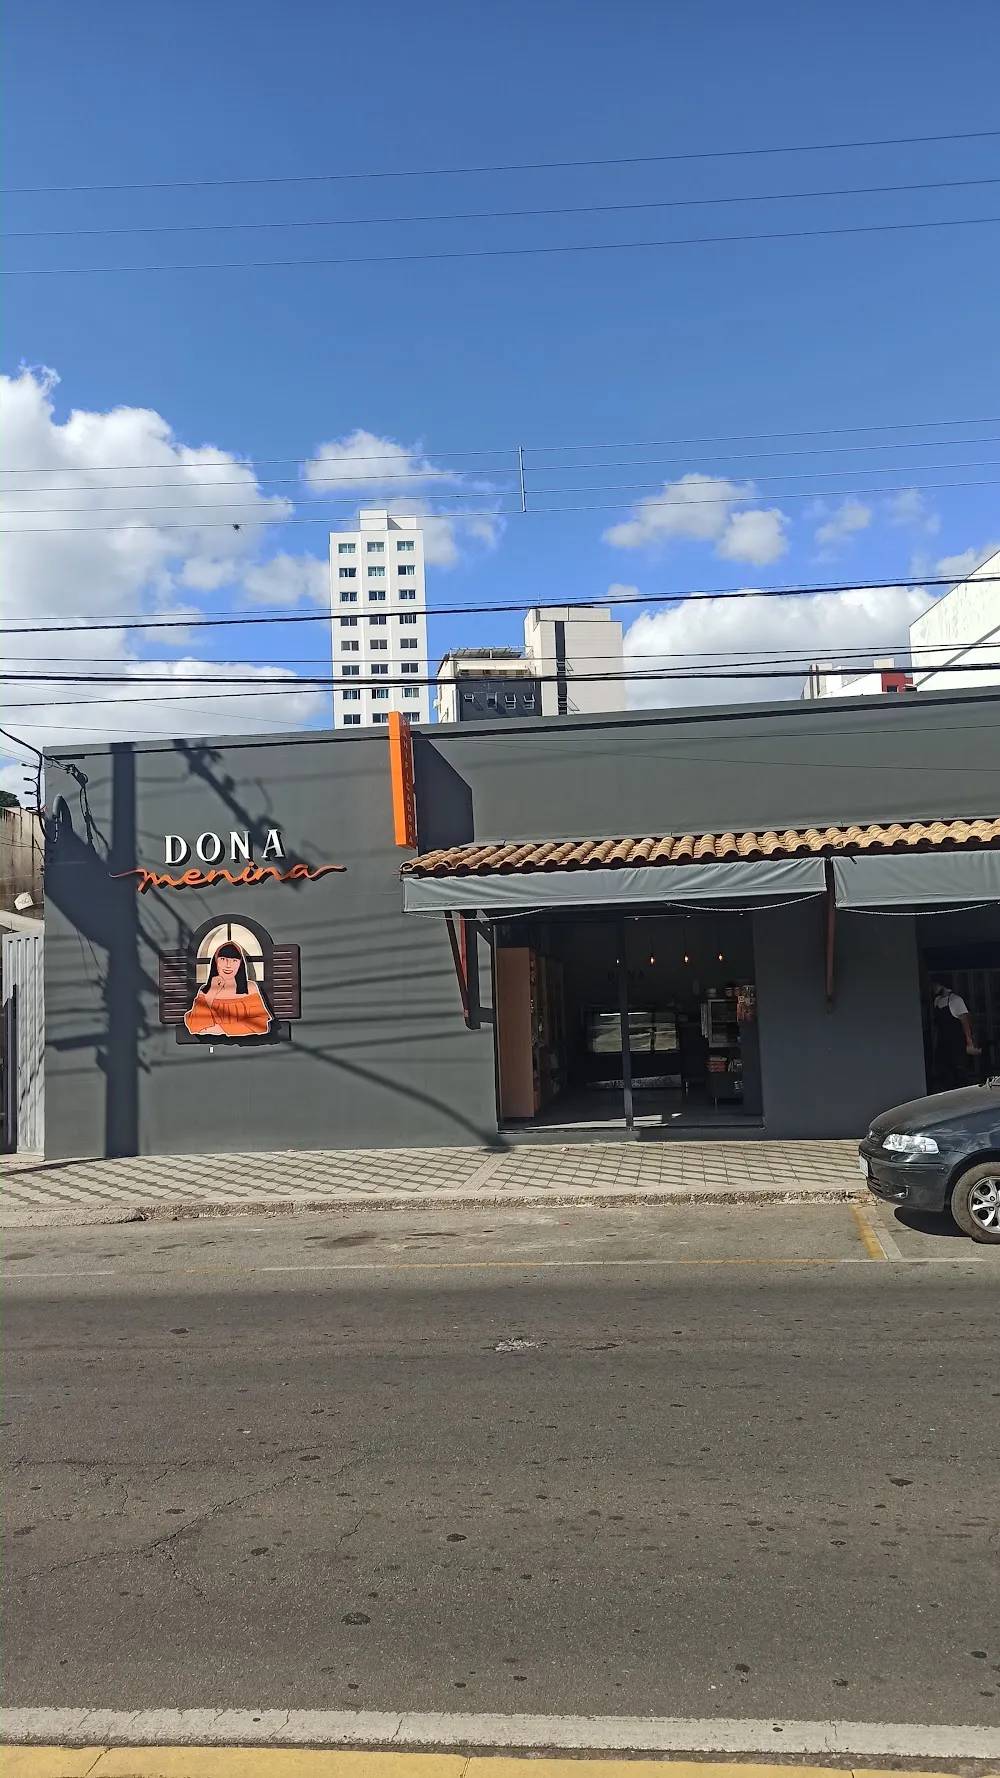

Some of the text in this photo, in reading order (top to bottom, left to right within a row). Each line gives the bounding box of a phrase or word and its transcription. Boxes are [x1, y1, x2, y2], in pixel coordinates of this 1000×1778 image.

[402, 719, 414, 844] PANIFICADORA
[164, 828, 285, 864] DONA
[109, 861, 346, 893] menina
[606, 969, 645, 982] DNA
